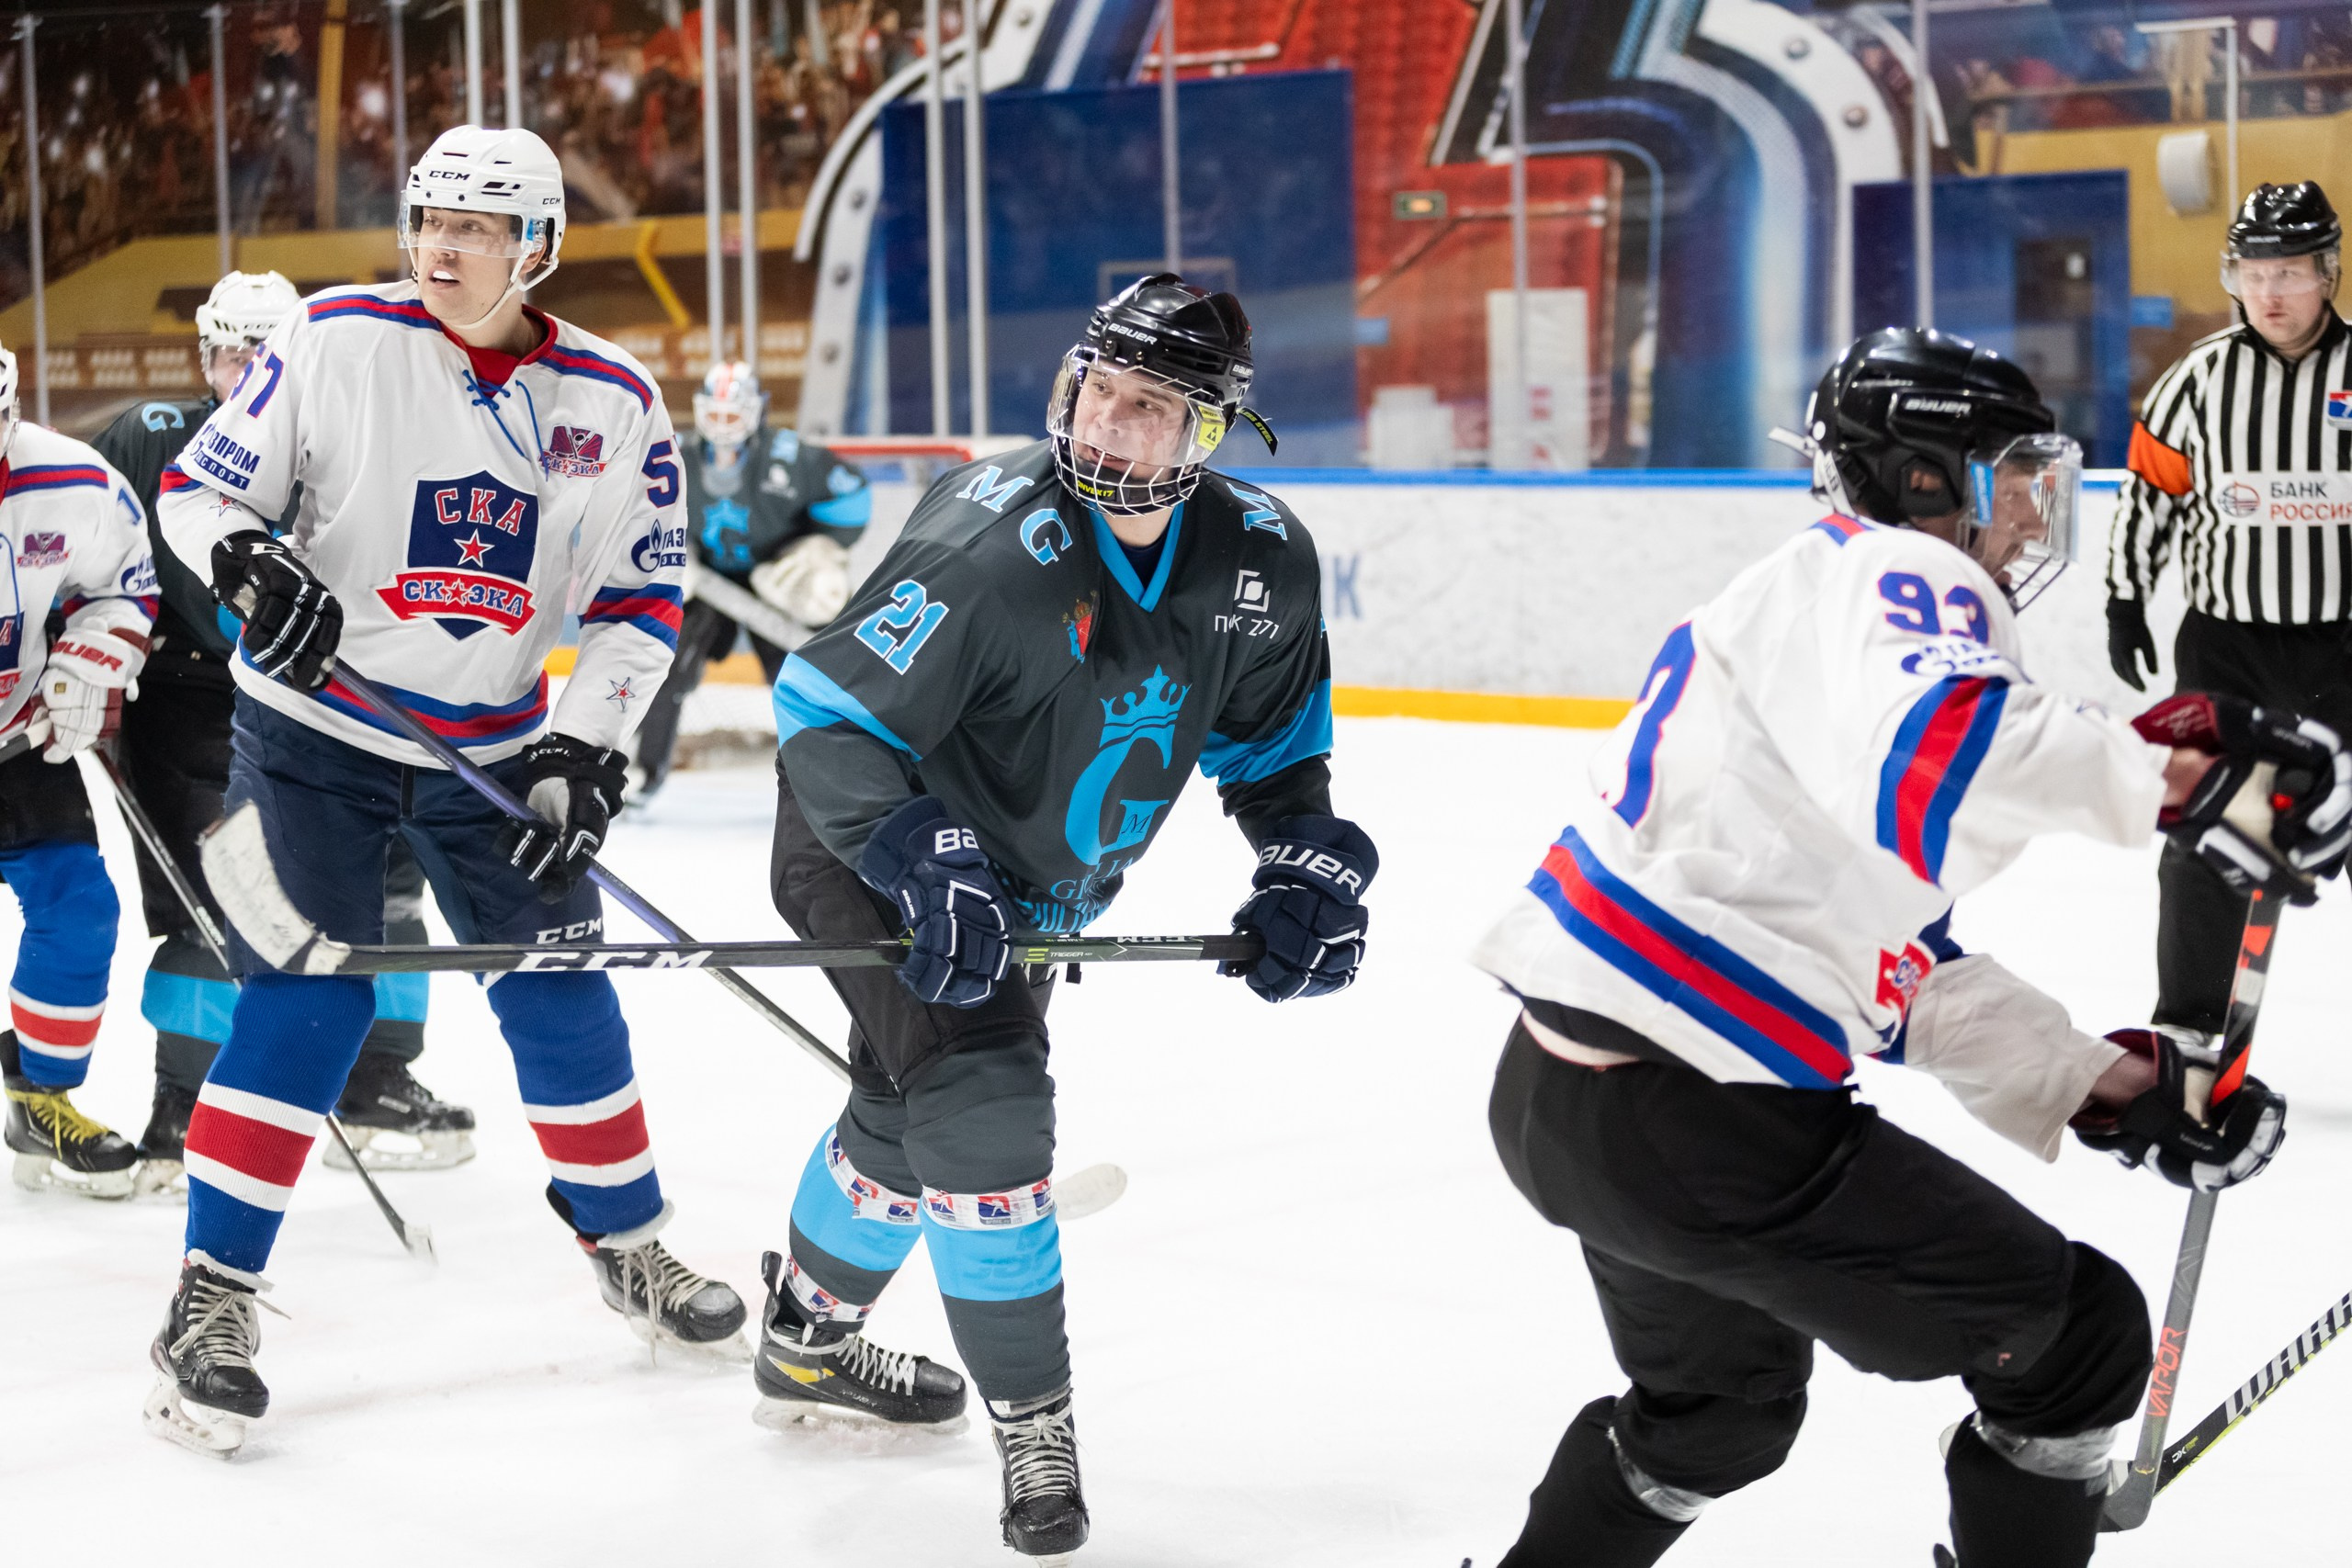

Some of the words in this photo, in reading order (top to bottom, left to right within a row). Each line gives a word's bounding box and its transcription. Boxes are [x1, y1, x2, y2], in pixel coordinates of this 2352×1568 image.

[429, 170, 471, 181] CCM
[1108, 322, 1158, 346] BAUER
[2270, 481, 2328, 499] БАНК
[435, 487, 526, 536] СКА
[854, 579, 950, 676] 21
[1259, 844, 1363, 896] AUER
[536, 917, 603, 945] CCM
[514, 950, 714, 973] CCM
